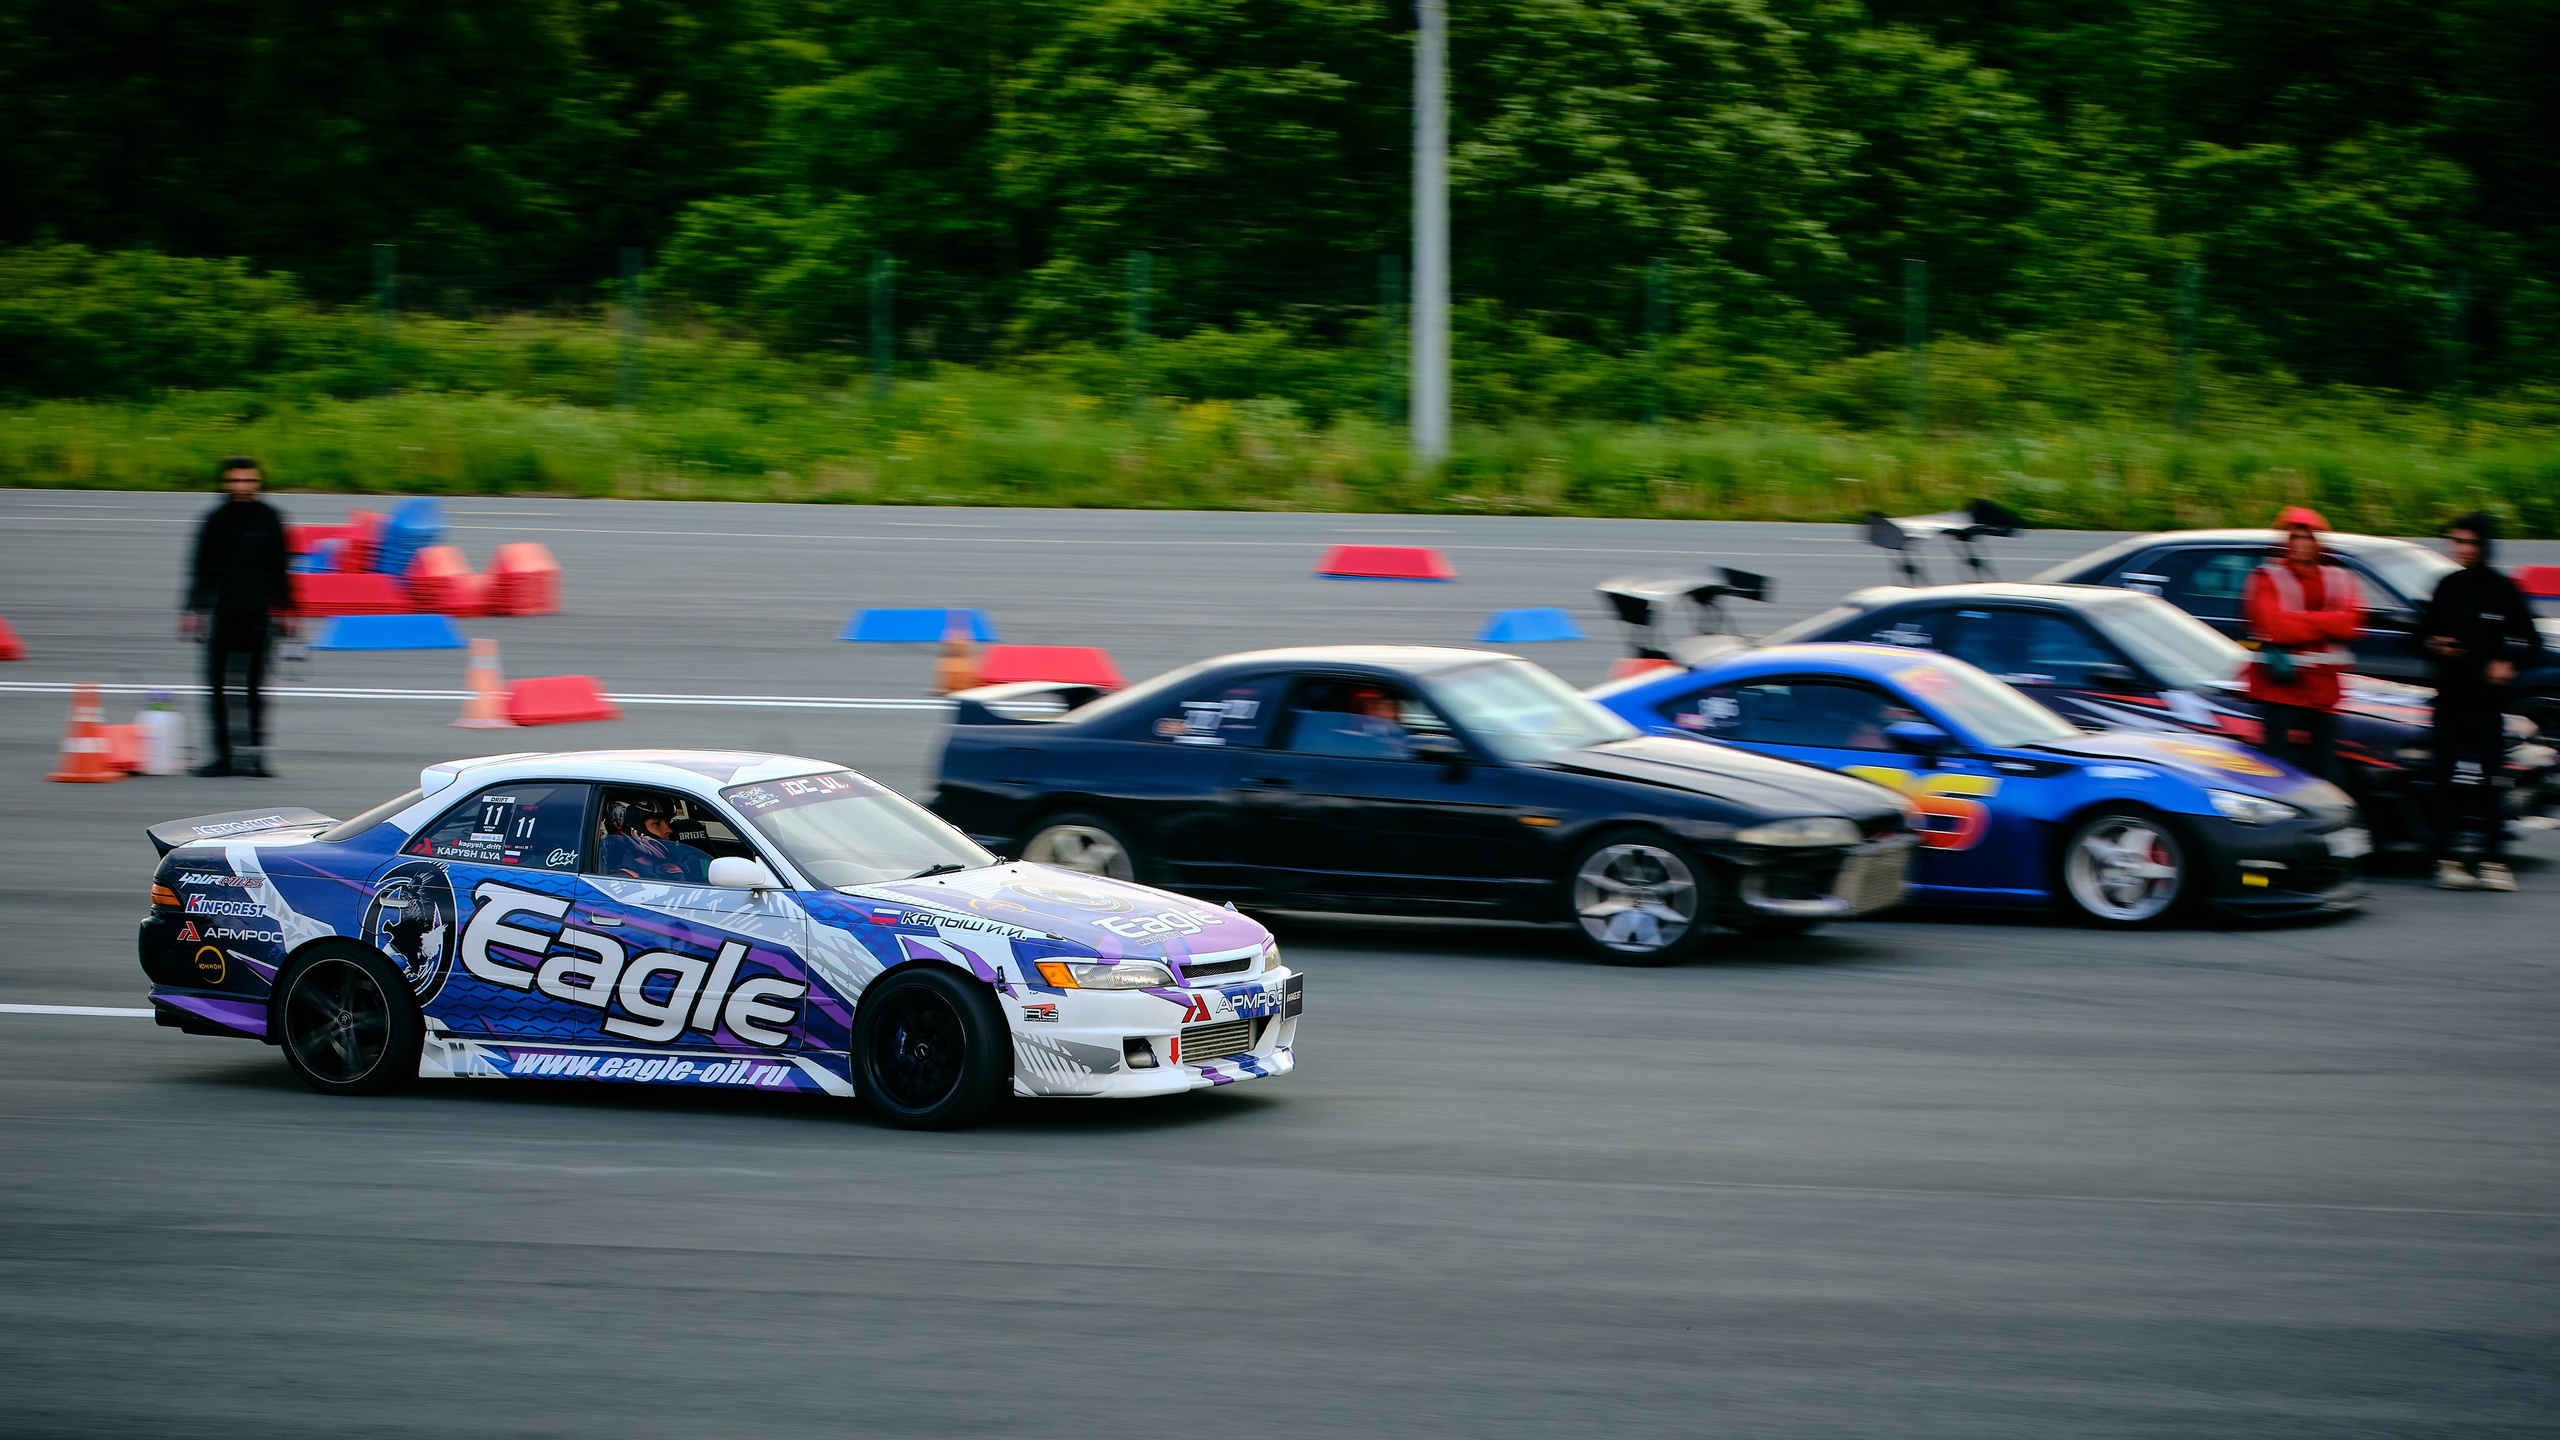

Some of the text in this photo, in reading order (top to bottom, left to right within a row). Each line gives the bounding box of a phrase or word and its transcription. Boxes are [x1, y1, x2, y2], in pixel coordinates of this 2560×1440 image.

[484, 805, 504, 826] 11
[516, 816, 536, 838] 11
[679, 831, 706, 840] BRIDE
[436, 846, 501, 861] KAPYSH ILYA
[185, 893, 268, 917] KINFOREST
[901, 911, 1027, 940] КАПЫШ И.И.
[1091, 907, 1223, 938] Eagle
[461, 881, 808, 1045] Eagle
[511, 1053, 791, 1086] www.eagle-oil.ru
